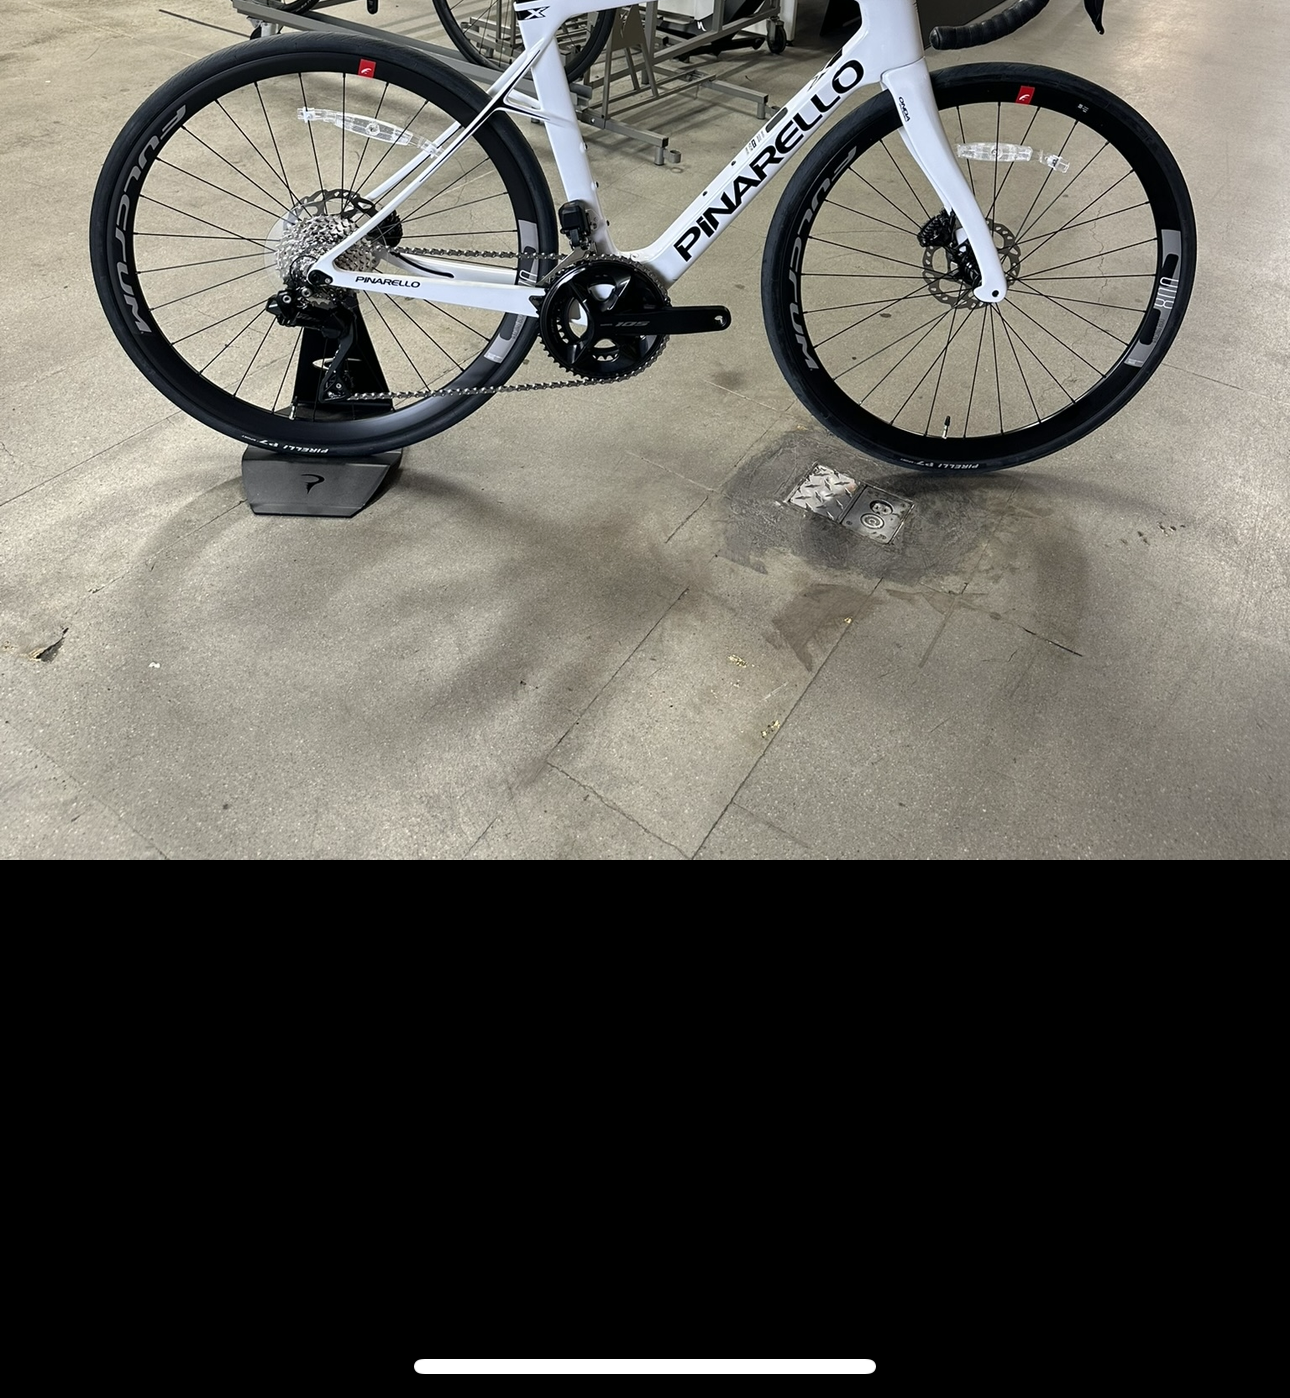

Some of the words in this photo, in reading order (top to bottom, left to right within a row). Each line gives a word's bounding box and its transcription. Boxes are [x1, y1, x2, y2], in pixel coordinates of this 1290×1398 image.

[674, 59, 865, 262] PINARELLO
[899, 96, 911, 122] ONDA
[115, 104, 187, 334] FULCRUM
[788, 146, 857, 370] FULCRUM
[355, 276, 421, 289] PINARELLO
[283, 444, 329, 454] PIRELLI
